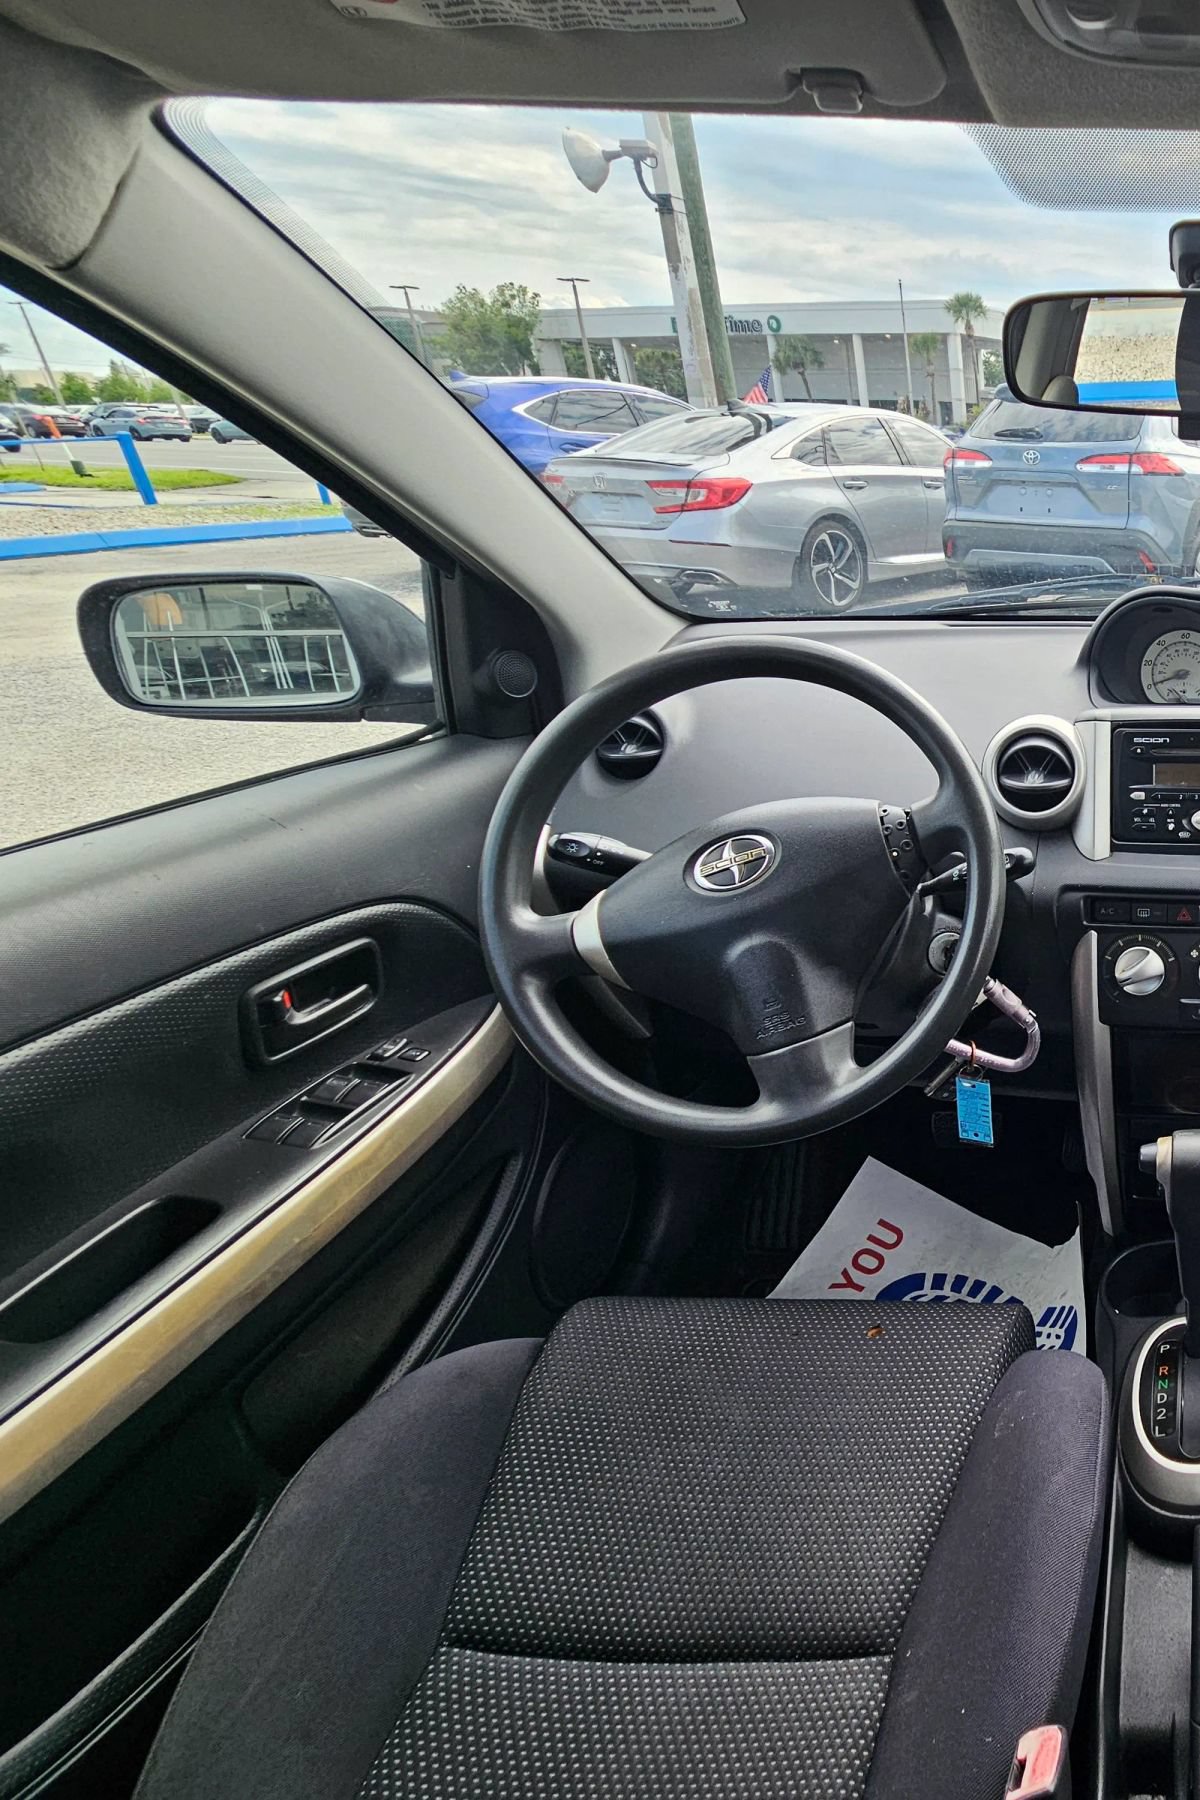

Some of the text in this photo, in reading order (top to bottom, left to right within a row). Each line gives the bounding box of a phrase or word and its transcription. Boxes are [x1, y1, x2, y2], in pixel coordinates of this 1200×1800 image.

[1143, 659, 1153, 667] 20
[827, 1217, 904, 1293] YOU
[1160, 1344, 1170, 1354] P
[1159, 1366, 1169, 1376] R
[1158, 1379, 1169, 1389] N
[1157, 1393, 1168, 1404] D
[1156, 1408, 1167, 1420] 2
[1155, 1425, 1166, 1437] L
